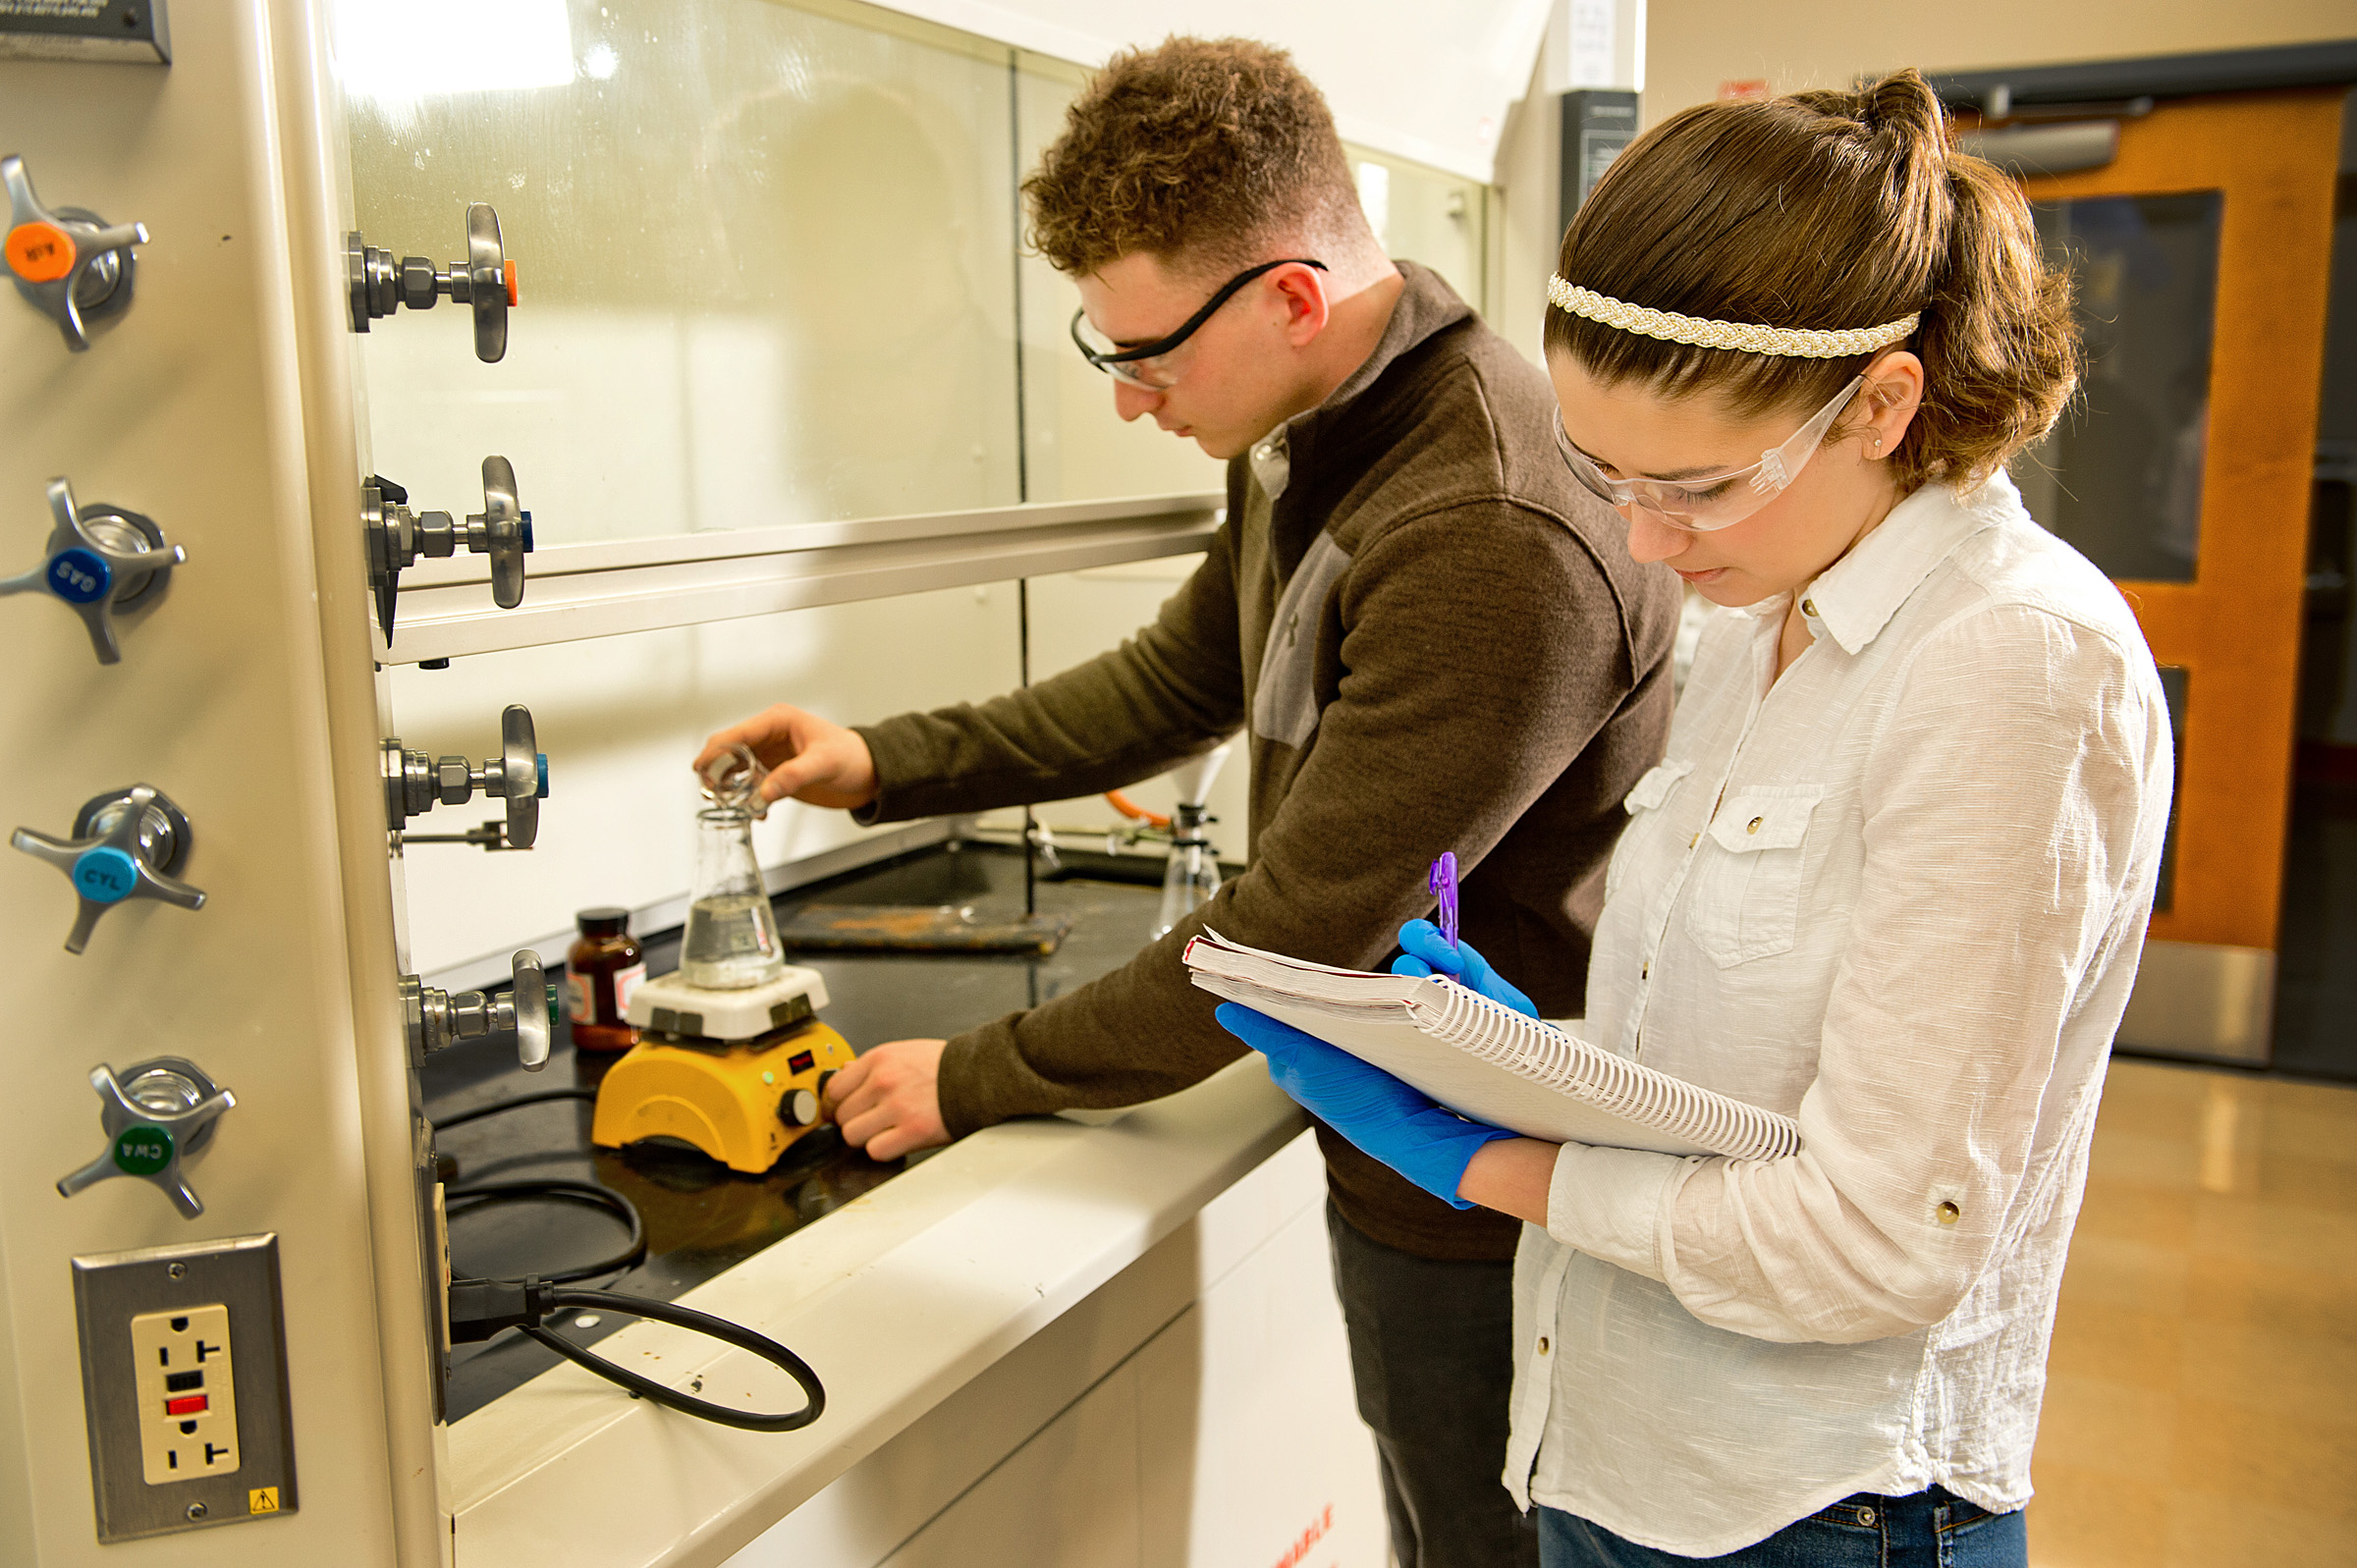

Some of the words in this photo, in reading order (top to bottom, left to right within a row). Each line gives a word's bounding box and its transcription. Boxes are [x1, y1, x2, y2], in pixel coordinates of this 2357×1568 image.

[56, 561, 96, 593] GAS
[83, 868, 121, 891] CYL
[122, 1143, 162, 1160] CWA
